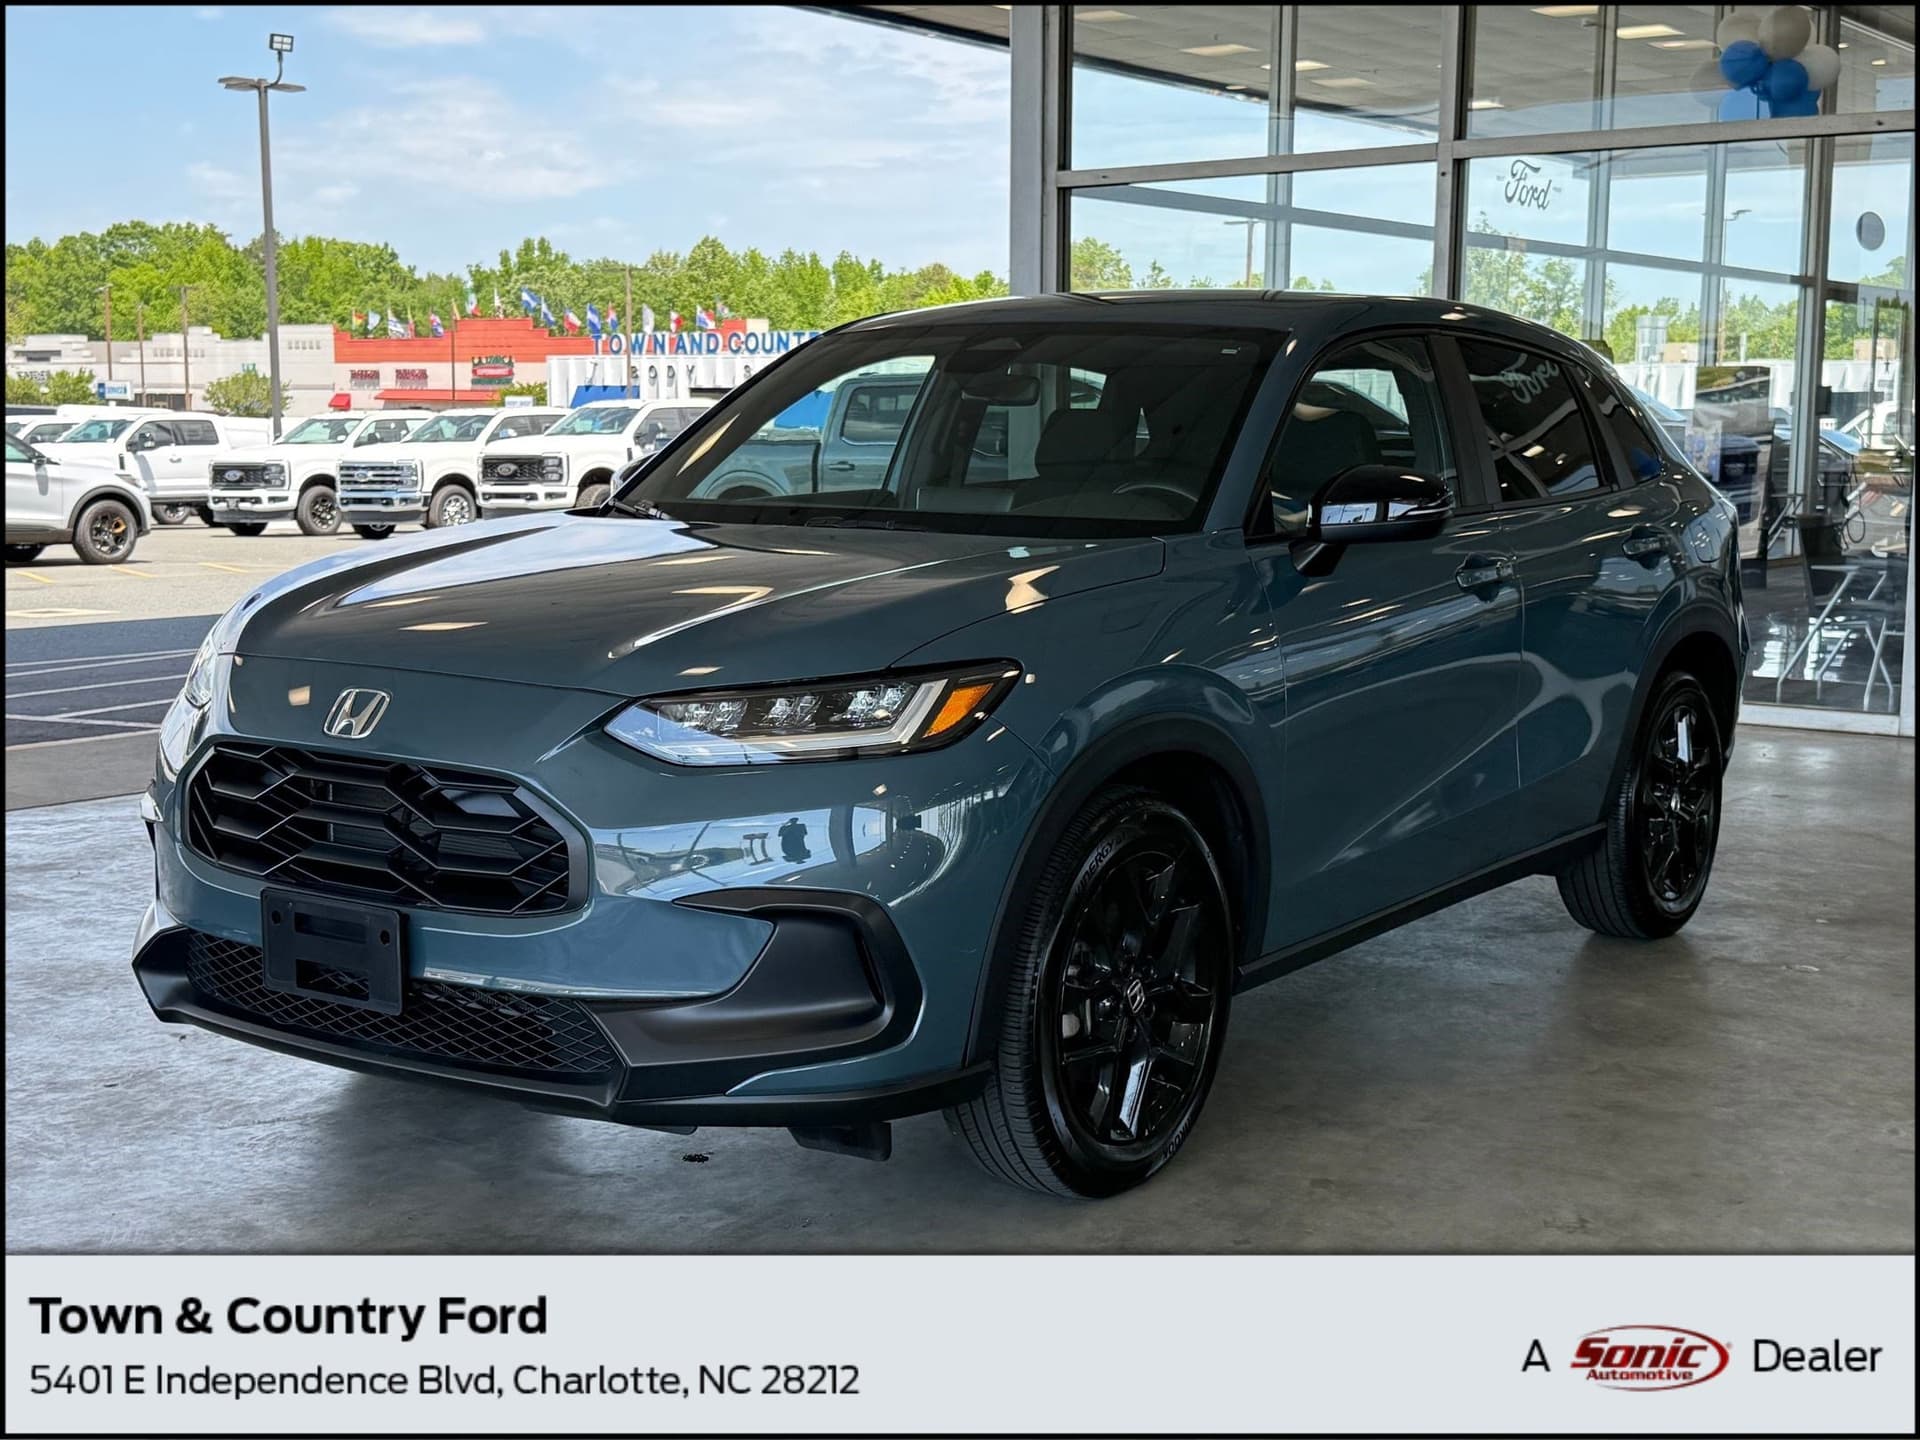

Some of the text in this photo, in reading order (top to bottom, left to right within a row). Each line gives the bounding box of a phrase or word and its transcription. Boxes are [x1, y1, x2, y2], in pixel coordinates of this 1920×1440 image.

[1504, 159, 1552, 210] Ford
[591, 331, 820, 355] TOWN AND COUNT
[630, 364, 696, 380] BODY
